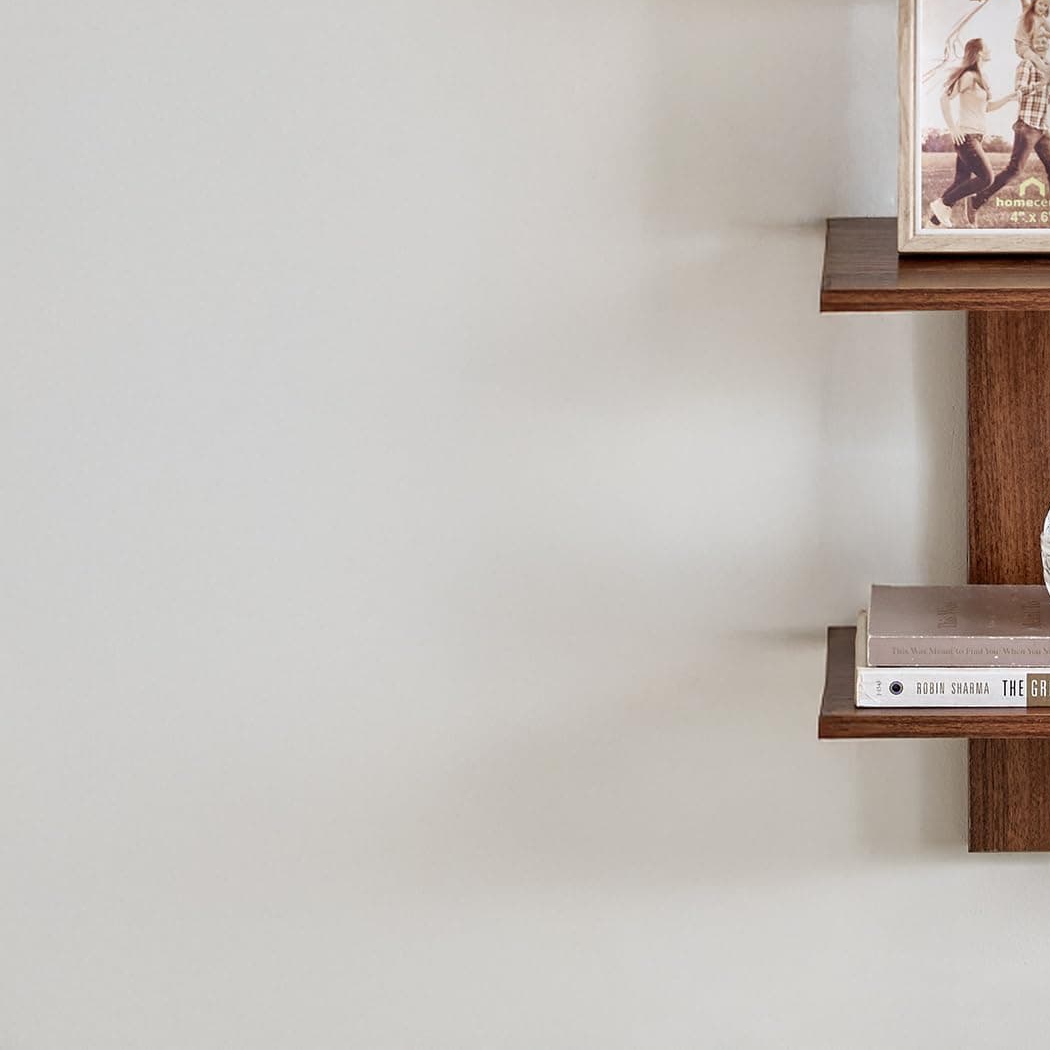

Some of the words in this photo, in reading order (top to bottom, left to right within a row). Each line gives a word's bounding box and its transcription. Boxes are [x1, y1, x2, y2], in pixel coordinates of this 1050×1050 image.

[917, 682, 945, 694] ROBIN
[951, 682, 990, 694] SHARMA
[1002, 679, 1024, 696] THE
